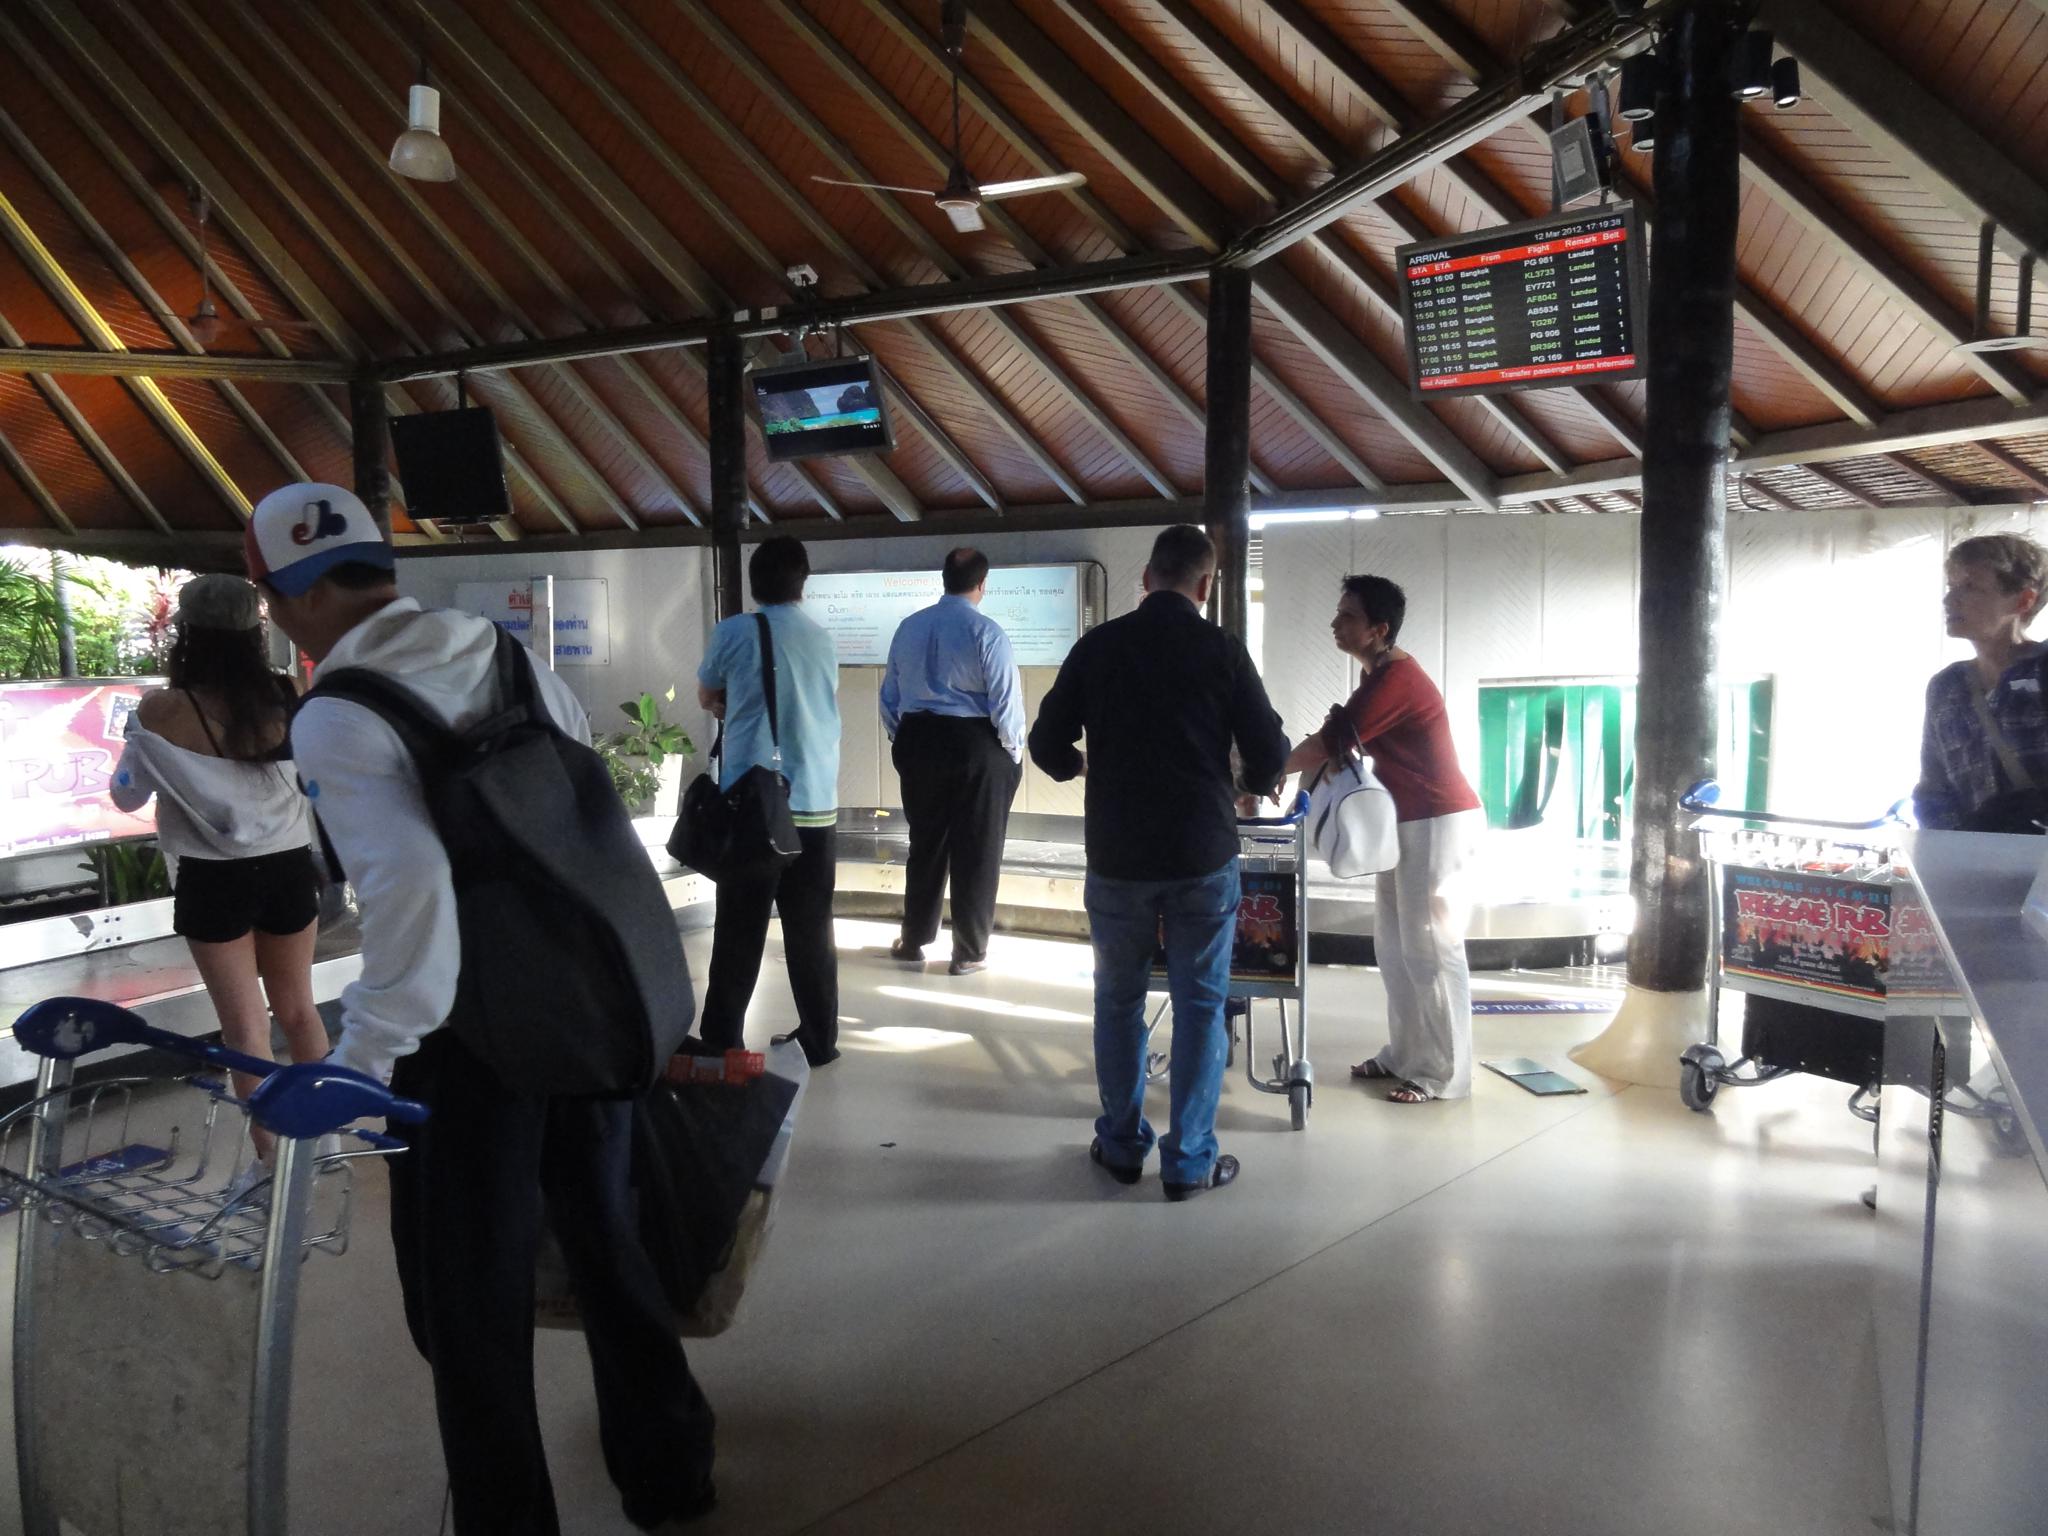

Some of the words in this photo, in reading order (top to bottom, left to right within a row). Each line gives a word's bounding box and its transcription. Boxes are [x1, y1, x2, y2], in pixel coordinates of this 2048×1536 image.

[1409, 251, 1450, 265] ARRIVAL
[1412, 266, 1427, 275] STA
[1435, 263, 1450, 271] ETA
[1481, 254, 1501, 262] From
[1528, 244, 1549, 254] Flight
[1565, 236, 1597, 247] Remark
[1603, 233, 1619, 241] Belt
[1460, 268, 1489, 279] Bangkok
[1524, 259, 1537, 267] PG
[1568, 249, 1594, 259] Landed
[1462, 280, 1490, 290] Bangkok
[1525, 269, 1555, 279] KL3733
[1569, 263, 1595, 271] Landed
[1463, 292, 1492, 302] Bangkok
[1526, 281, 1555, 291] EY7721
[1570, 275, 1596, 284] Landed
[1464, 304, 1492, 313] Bangkok
[1571, 288, 1597, 296] Landed
[1465, 315, 1494, 325] Bangkok
[1572, 300, 1598, 309] Landed
[1466, 327, 1495, 337] Bangkok
[1573, 313, 1598, 321] Landed
[1467, 339, 1496, 348] Bangkok
[1531, 331, 1543, 339] PG
[1574, 325, 1600, 334] Landed
[1469, 350, 1497, 359] Bangkok
[1575, 337, 1601, 346] Landed
[1470, 362, 1498, 371] Bangkok
[1533, 355, 1545, 363] PG
[1576, 349, 1602, 358] Landed
[1500, 369, 1531, 379] Transfer
[1533, 365, 1574, 376] passenger
[884, 576, 928, 587] Welcome
[8, 750, 112, 799] PUB
[1735, 874, 1803, 893] WELCOME
[1734, 889, 1831, 931] REGGAE
[1833, 902, 1891, 937] PUB
